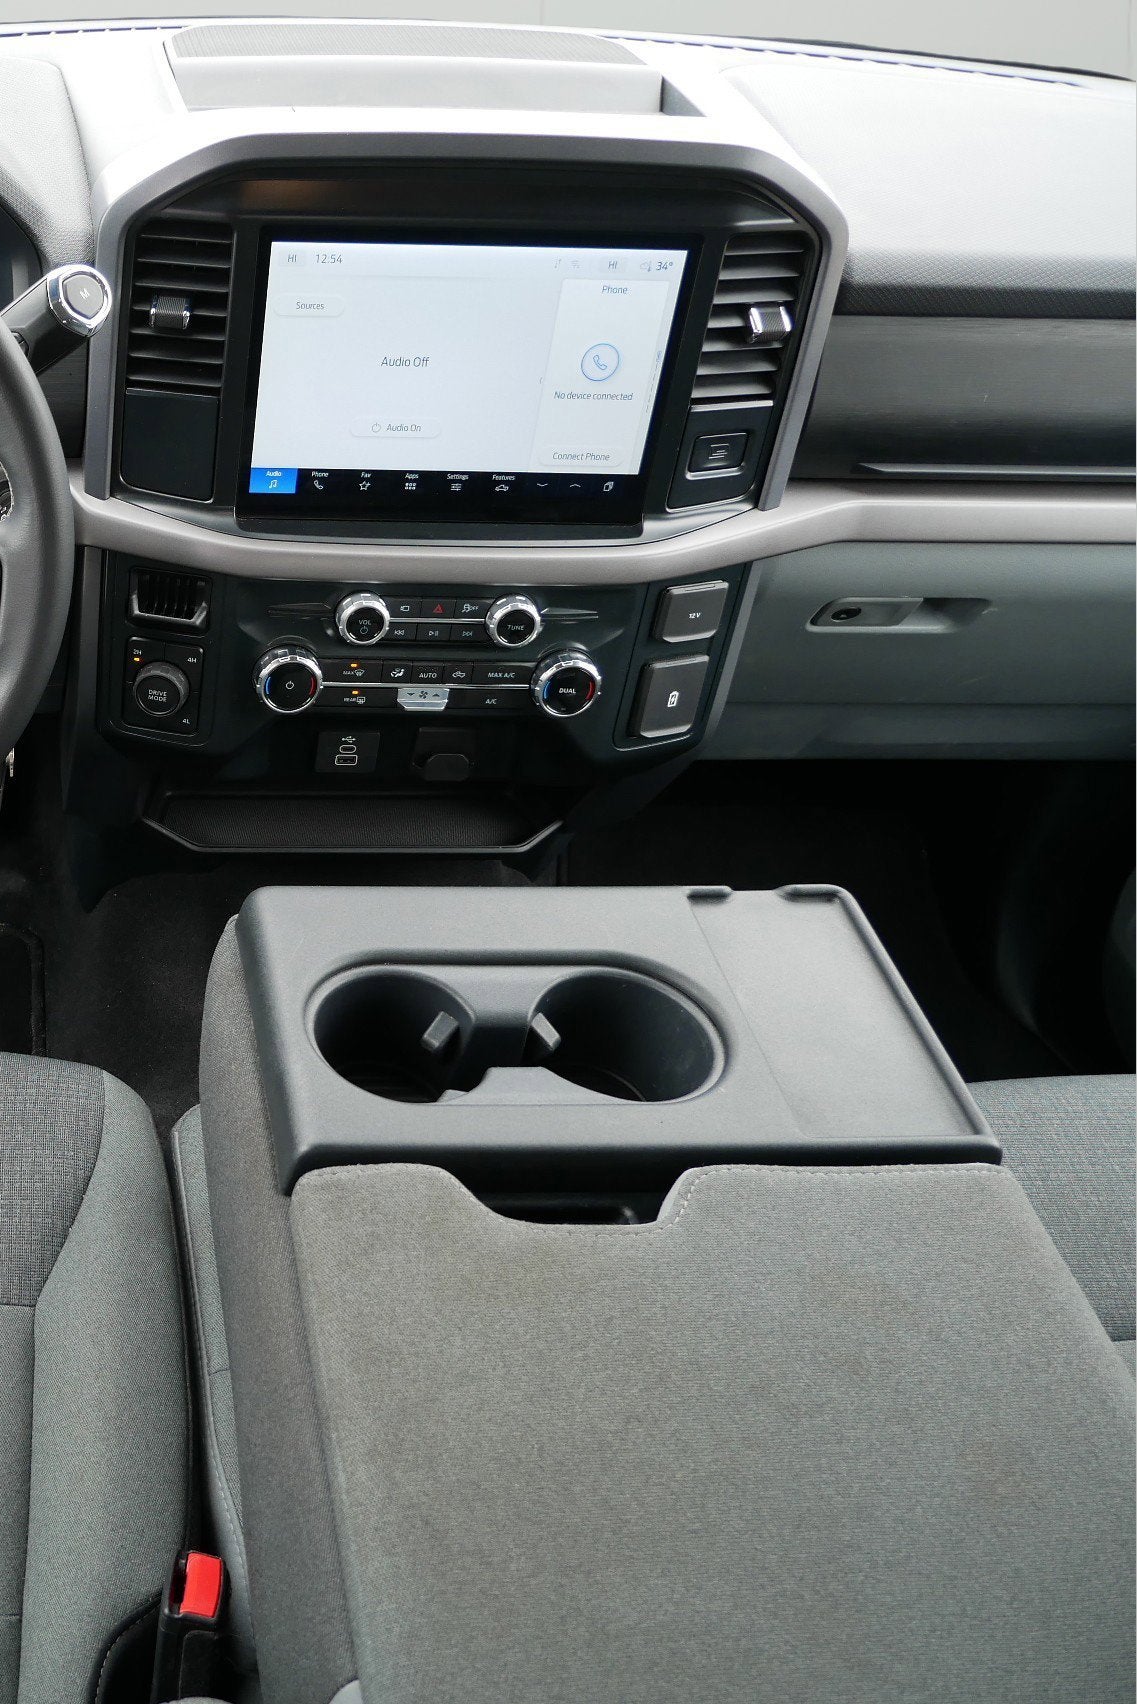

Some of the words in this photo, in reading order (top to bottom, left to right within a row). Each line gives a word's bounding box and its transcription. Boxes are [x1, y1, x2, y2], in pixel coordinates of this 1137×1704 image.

[655, 261, 673, 271] 34°
[602, 285, 629, 295] Phone
[296, 301, 325, 311] Sources
[380, 355, 411, 367] Audio
[413, 355, 431, 367] Off
[553, 391, 566, 400] No
[566, 391, 592, 401] device
[592, 392, 634, 401] connected
[386, 423, 409, 432] Audio
[410, 423, 421, 432] On
[552, 452, 584, 461] Connect
[585, 452, 611, 462] Phone
[266, 470, 282, 478] Audio
[311, 470, 329, 478] Phone
[360, 471, 371, 479] Fav
[404, 472, 419, 481] Apps
[447, 473, 469, 481] Settings
[492, 474, 516, 482] Features
[148, 689, 168, 697] DRIVE
[147, 695, 168, 703] MODE
